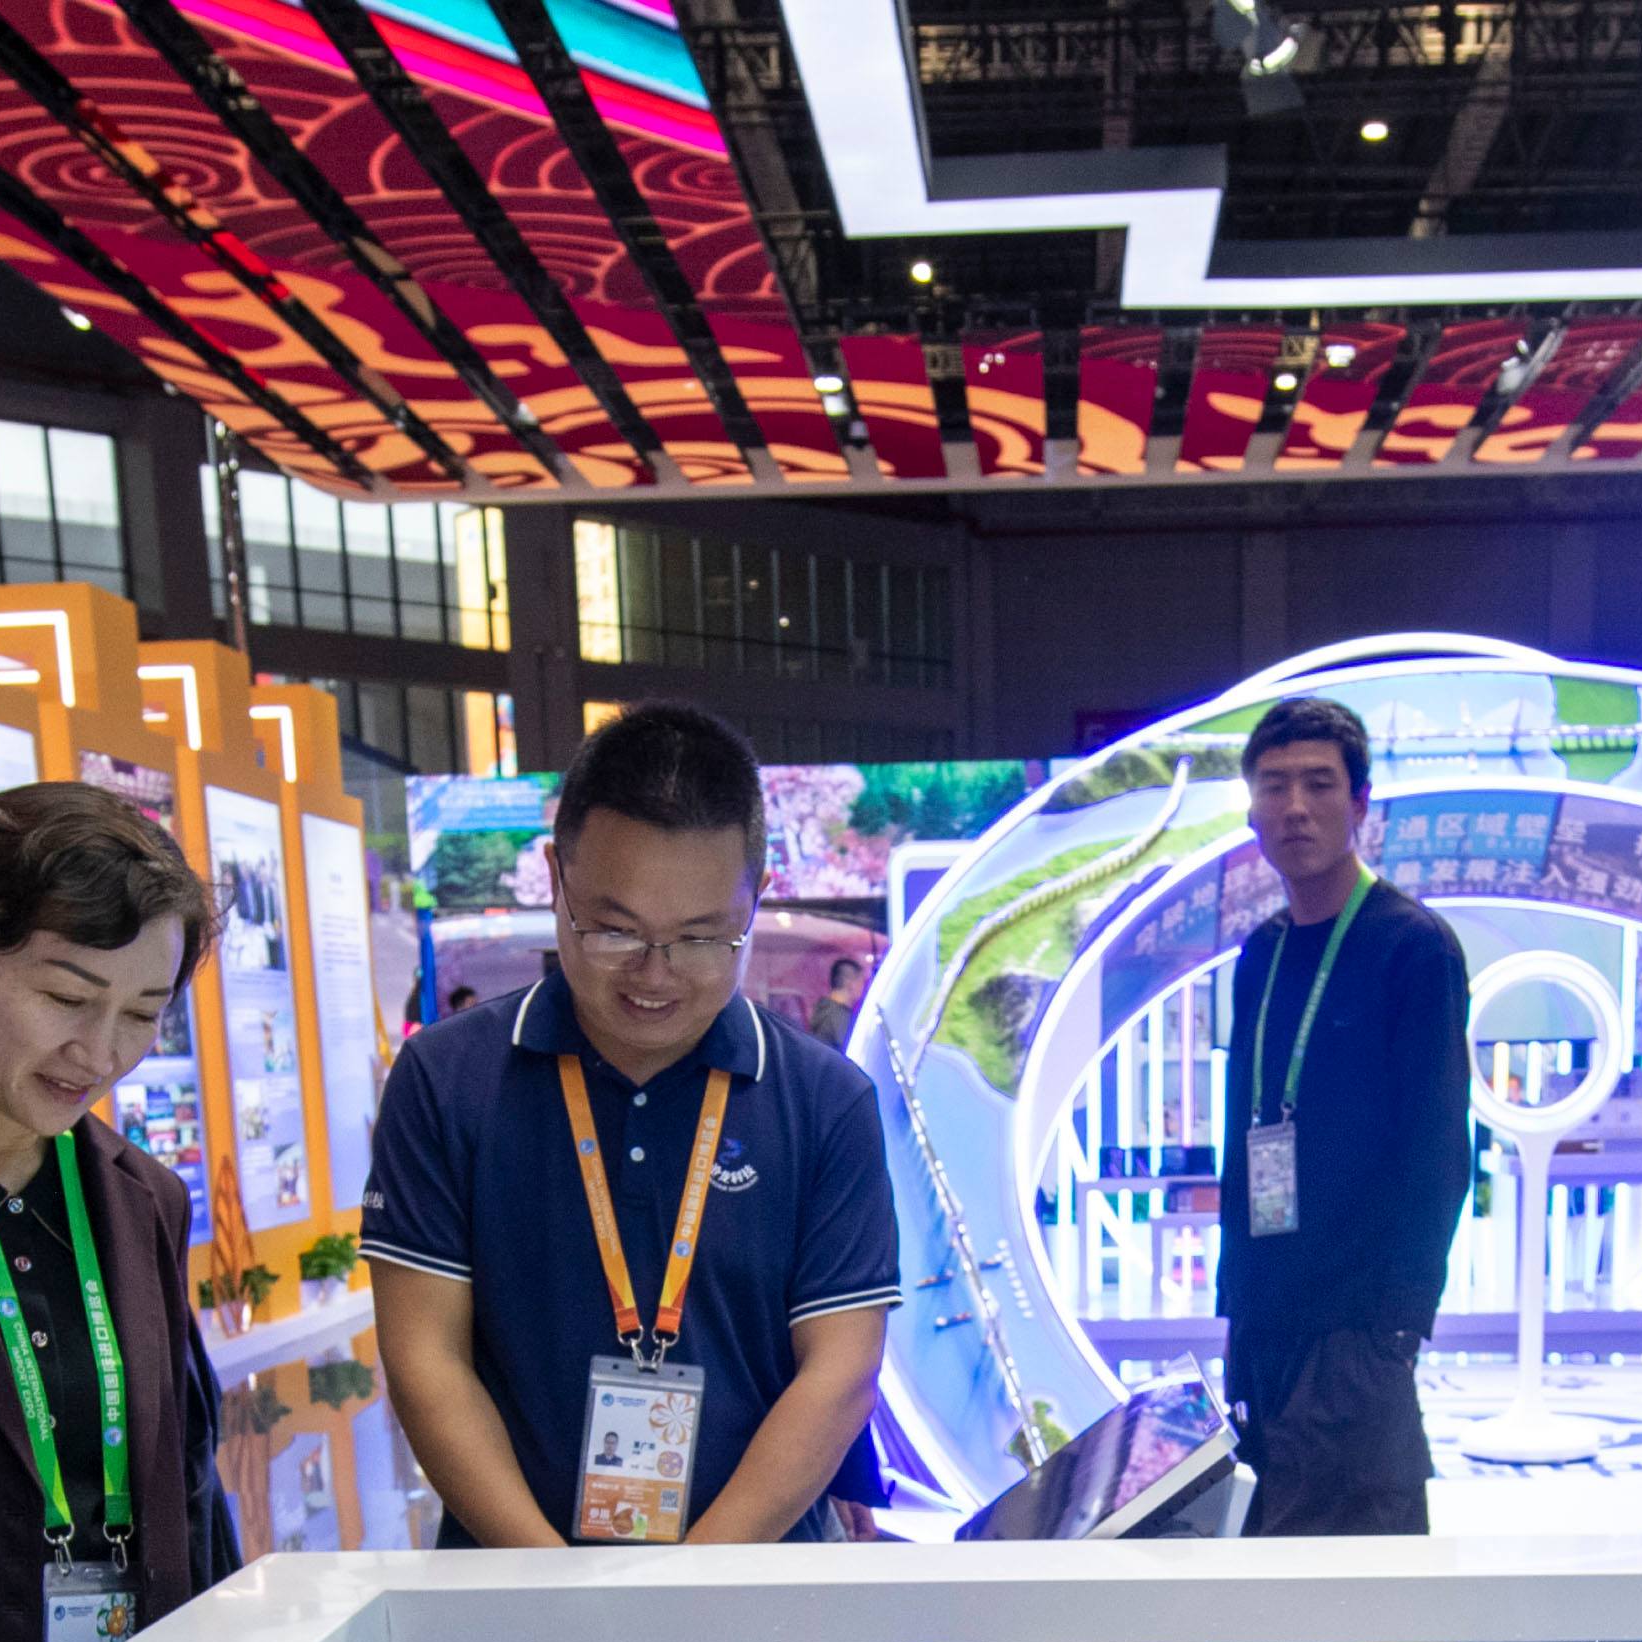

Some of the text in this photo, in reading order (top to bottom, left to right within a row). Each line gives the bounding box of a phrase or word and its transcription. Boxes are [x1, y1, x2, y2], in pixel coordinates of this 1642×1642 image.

[9, 1345, 37, 1421] IMPORT EXPO
[12, 1320, 50, 1442] CHINA INTERNATIONAL
[84, 1278, 120, 1423] 中国国际进口博览会
